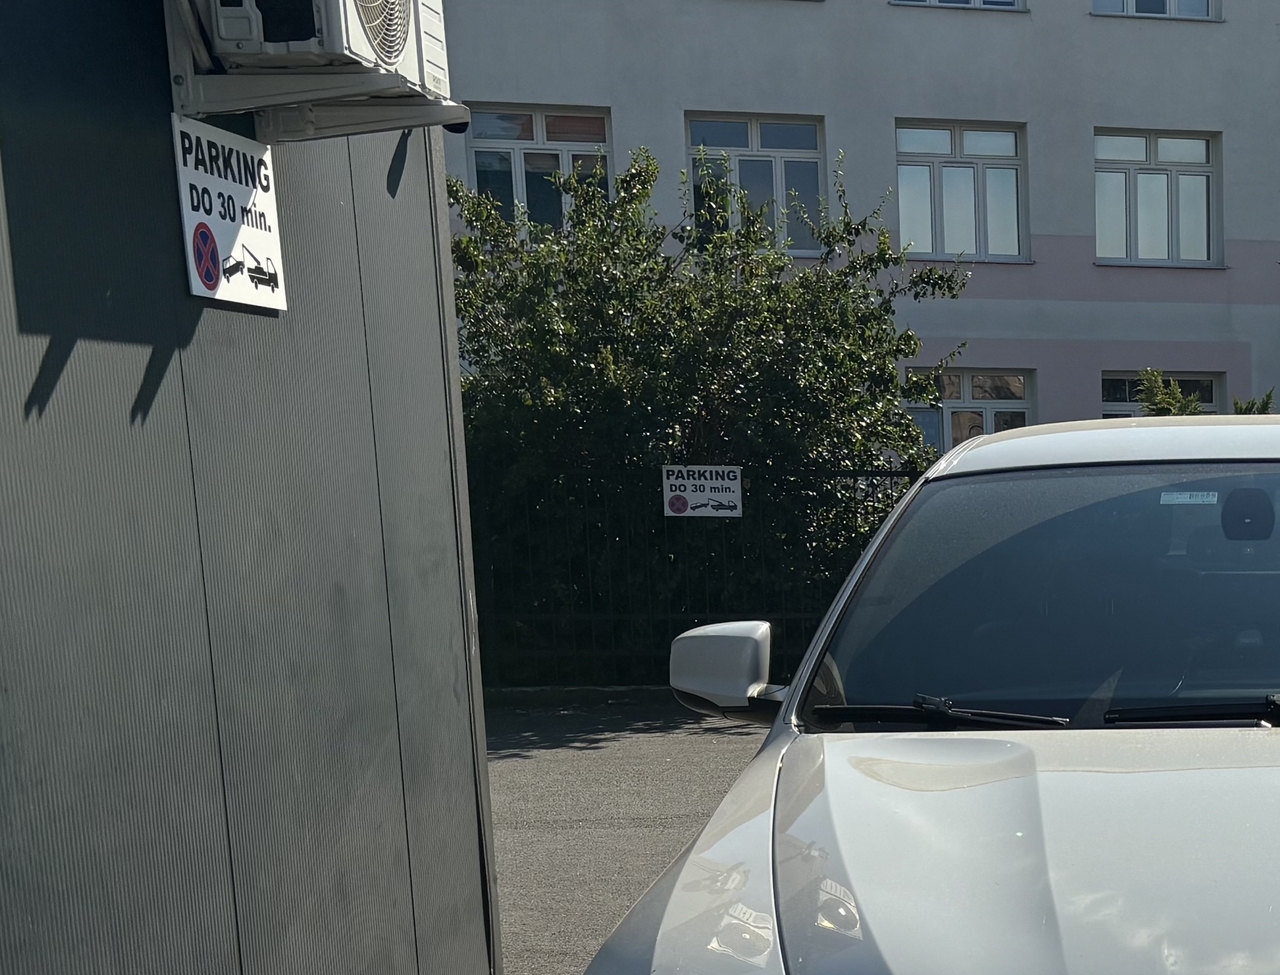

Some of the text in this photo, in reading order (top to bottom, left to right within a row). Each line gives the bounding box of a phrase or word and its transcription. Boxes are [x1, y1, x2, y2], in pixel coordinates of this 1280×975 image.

[180, 130, 270, 193] PARKING
[189, 182, 272, 233] DO 30 min.
[666, 469, 738, 481] PARKING
[669, 484, 735, 493] DO 30 min.
